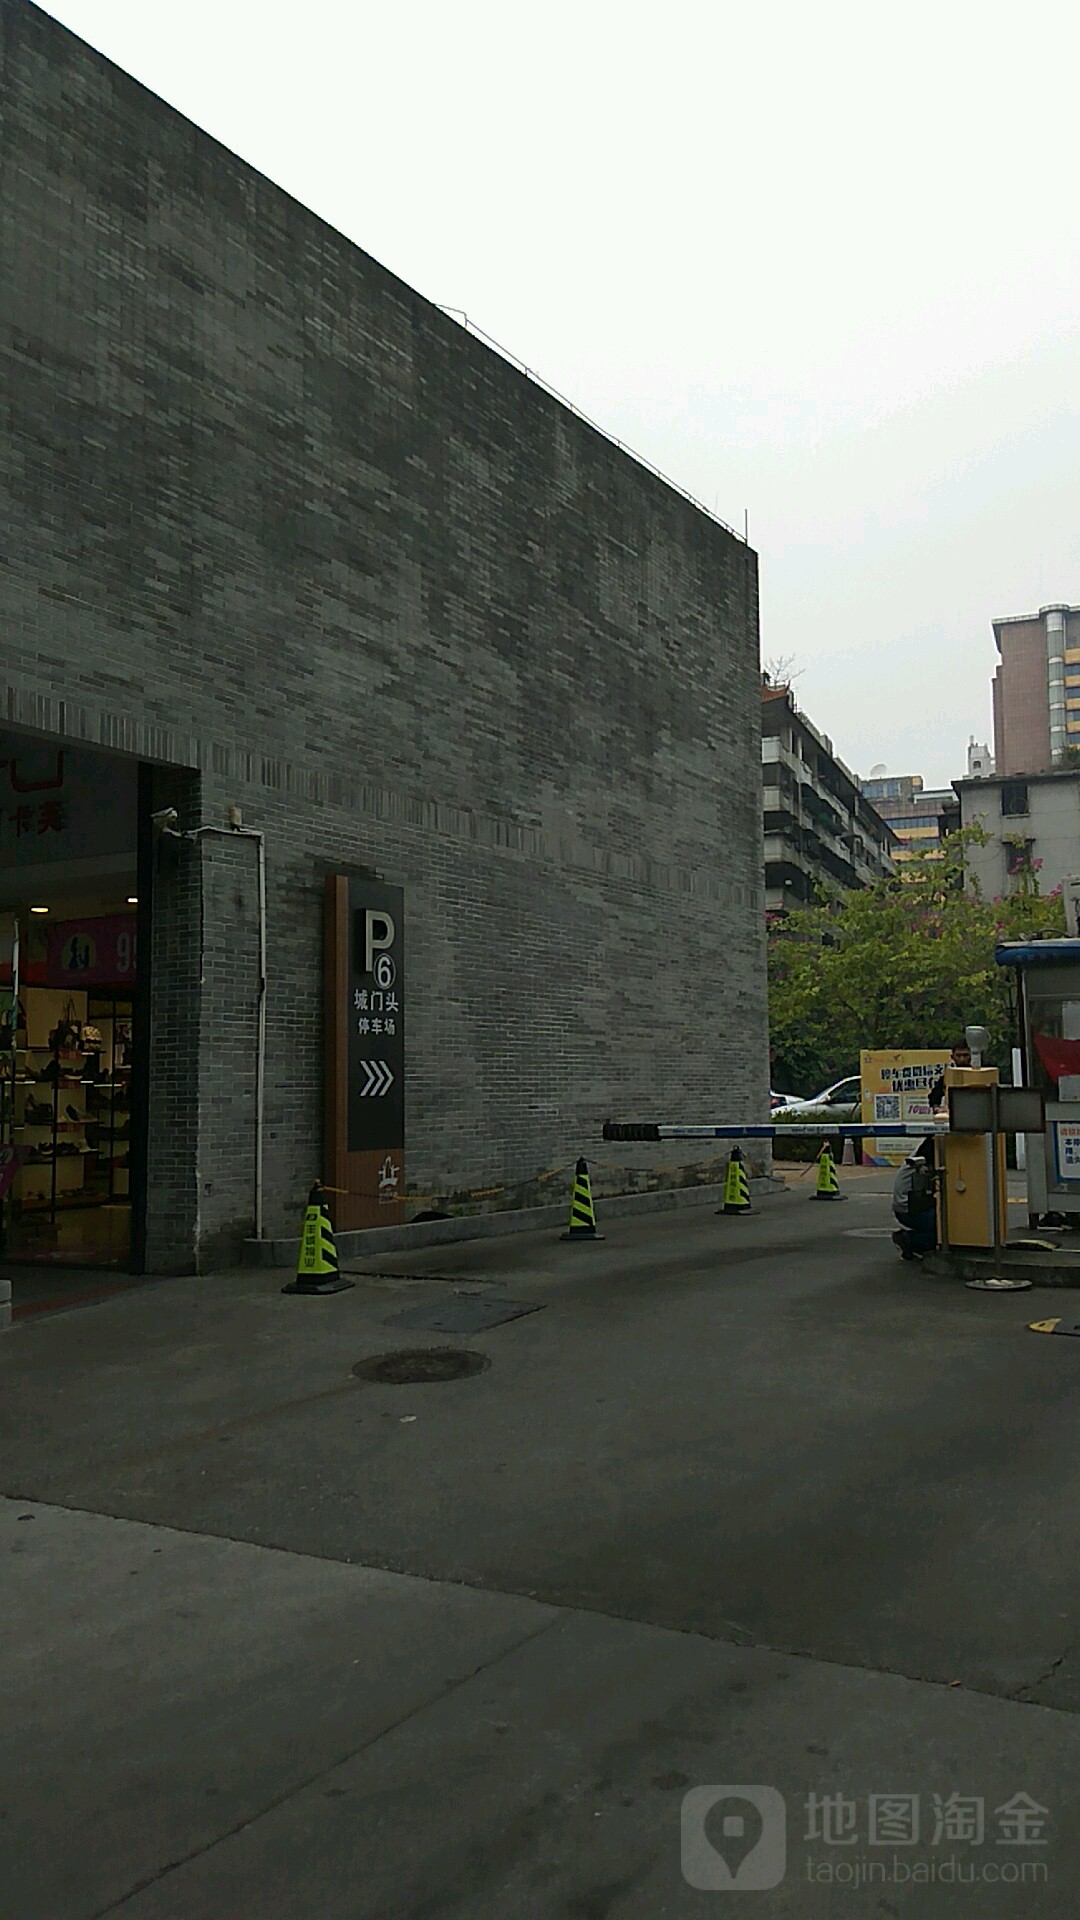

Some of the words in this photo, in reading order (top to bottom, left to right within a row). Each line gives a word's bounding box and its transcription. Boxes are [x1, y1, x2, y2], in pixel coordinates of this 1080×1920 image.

[365, 909, 396, 973] P
[353, 988, 400, 1013] 城门头
[357, 1016, 396, 1036] 停车场
